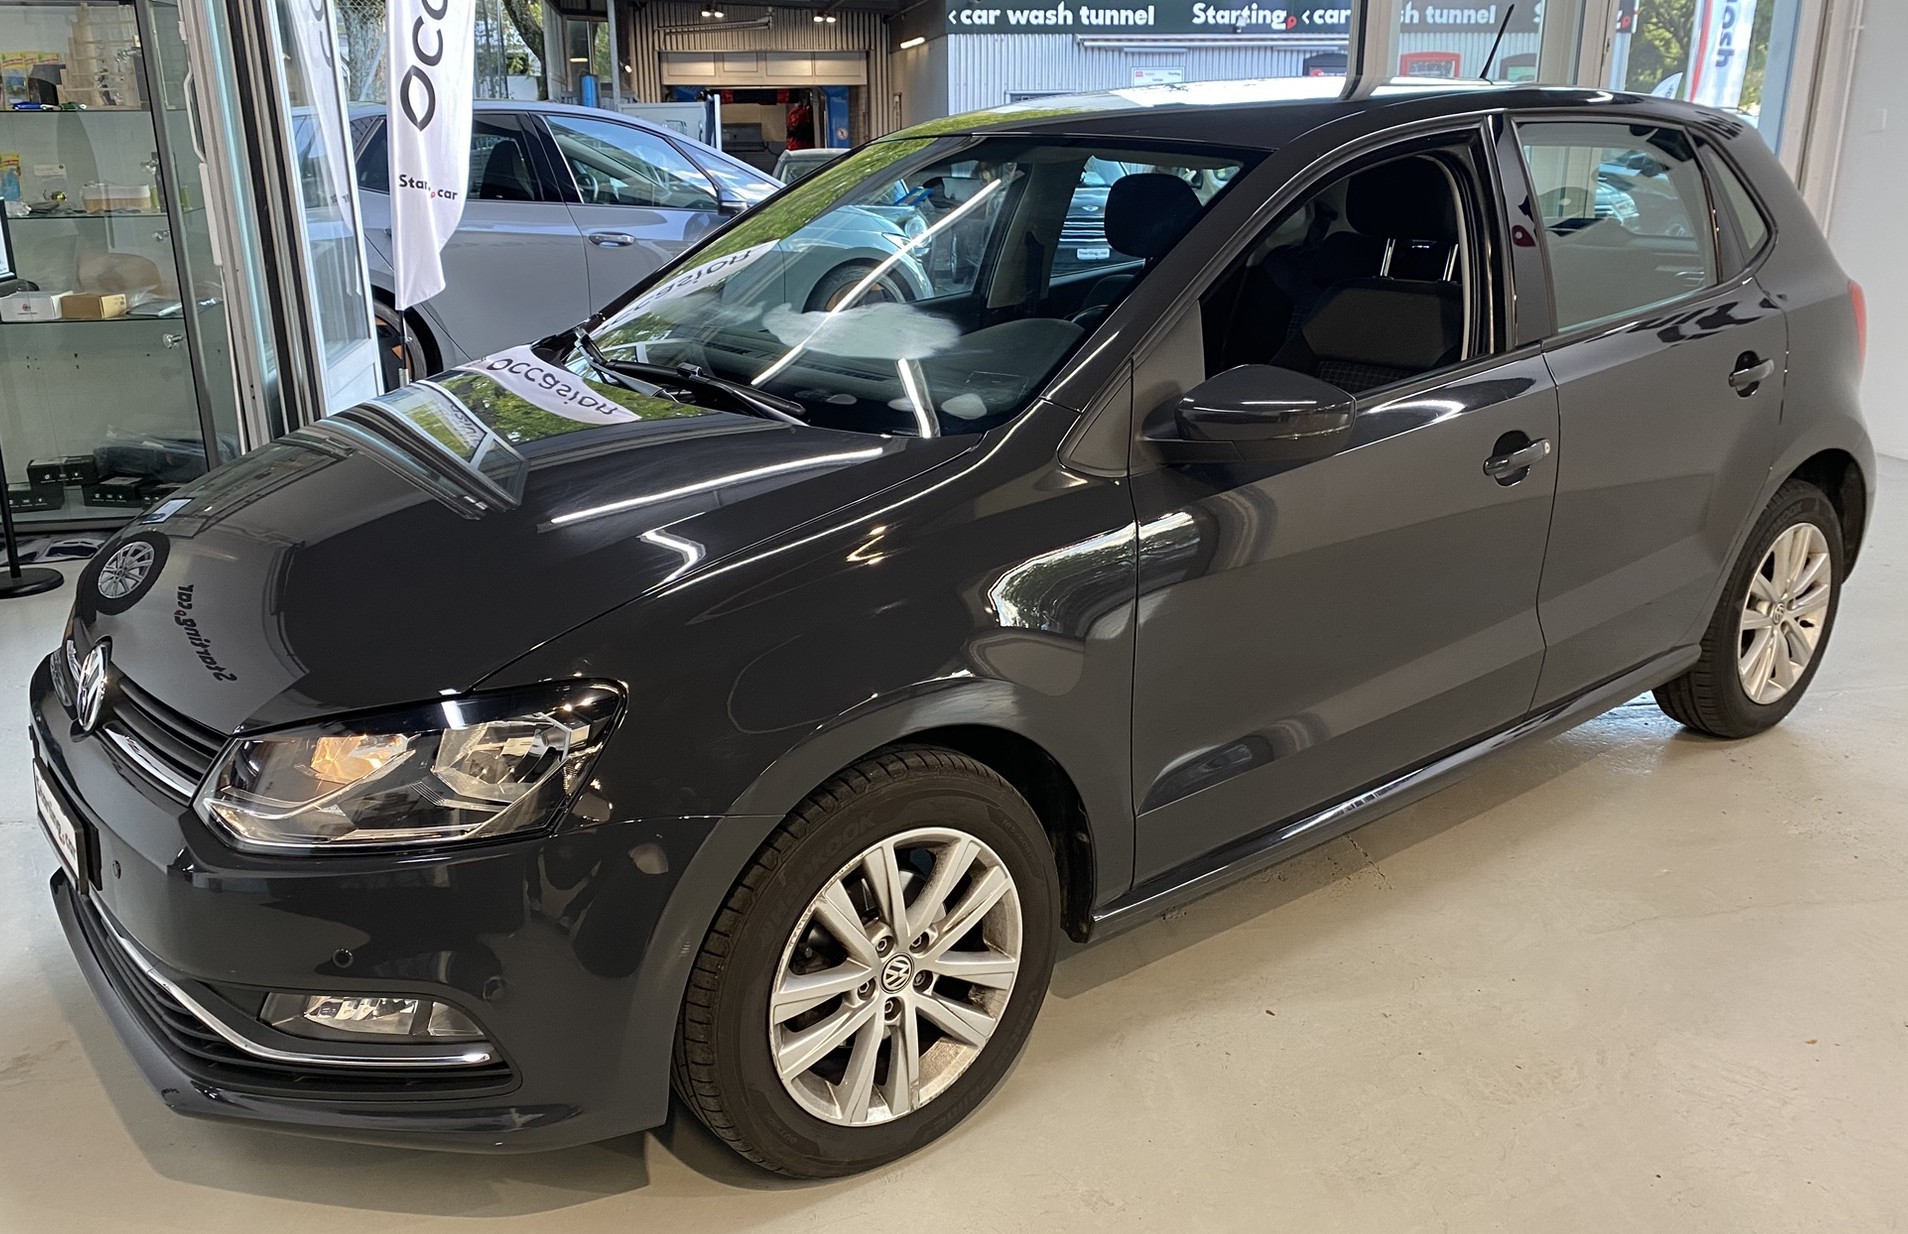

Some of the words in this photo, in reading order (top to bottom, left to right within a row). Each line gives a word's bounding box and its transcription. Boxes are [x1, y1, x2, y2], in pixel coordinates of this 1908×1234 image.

[960, 9, 1001, 25] car
[1006, 1, 1073, 25] wash
[1079, 5, 1155, 25] tunnel
[1192, 2, 1287, 30] Starting
[1313, 9, 1351, 24] car
[1425, 5, 1496, 24] tunnel
[1715, 0, 1737, 67] ash
[437, 188, 459, 201] car
